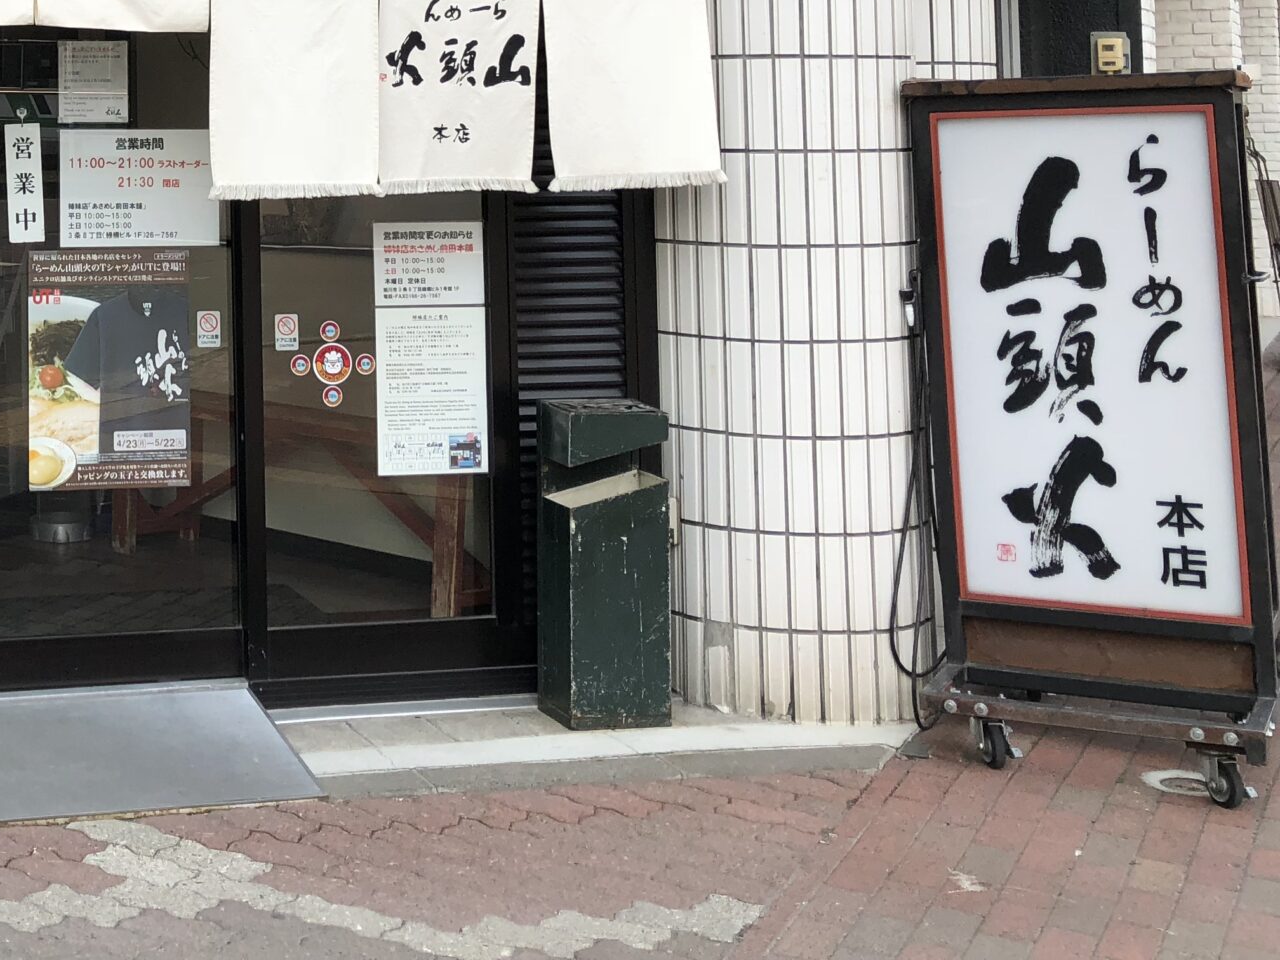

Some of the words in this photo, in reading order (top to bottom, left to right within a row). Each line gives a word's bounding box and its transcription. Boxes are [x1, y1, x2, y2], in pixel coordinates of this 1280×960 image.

[432, 123, 471, 144] 本店
[115, 137, 165, 151] 営業時間
[158, 160, 209, 169] ラストオーダー
[12, 137, 37, 233] 営業中
[117, 176, 154, 188] 21:30
[162, 178, 180, 188] 閉店
[68, 212, 82, 220] 平日
[68, 222, 82, 230] 土日
[384, 257, 397, 265] 平日
[1126, 133, 1188, 384] らーめん
[980, 155, 1121, 580] 山頭火
[1156, 495, 1208, 590] 本店
